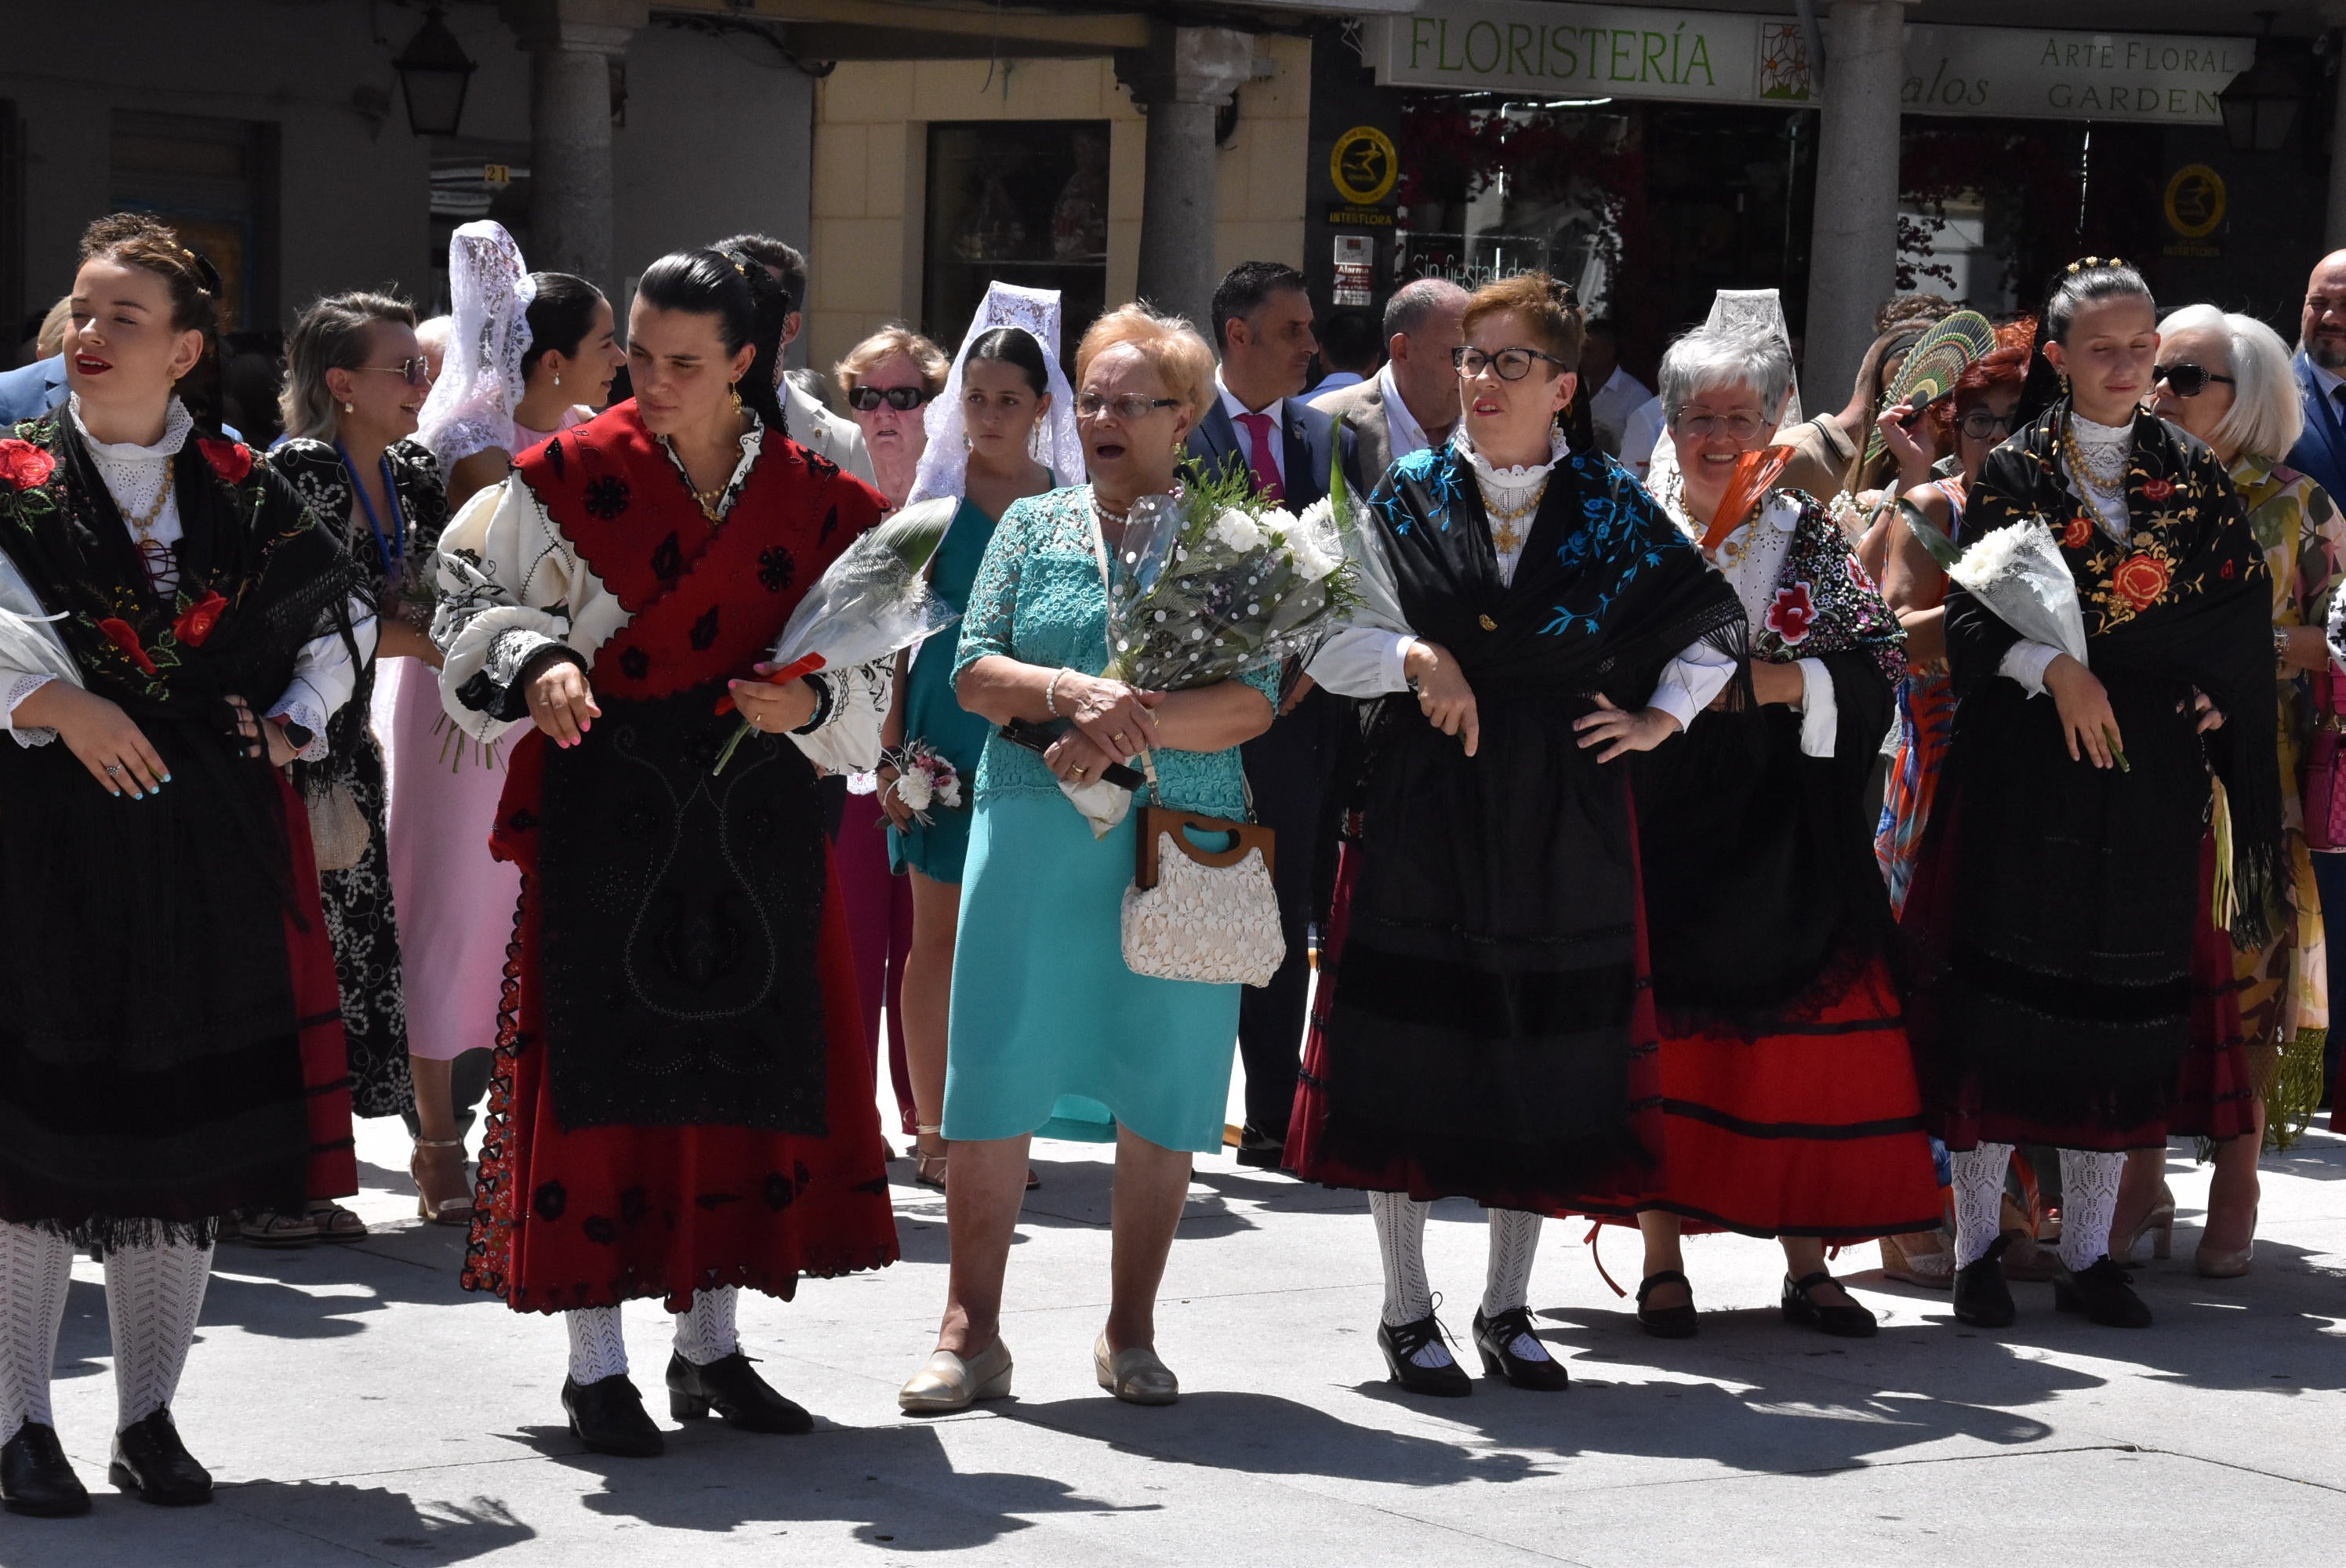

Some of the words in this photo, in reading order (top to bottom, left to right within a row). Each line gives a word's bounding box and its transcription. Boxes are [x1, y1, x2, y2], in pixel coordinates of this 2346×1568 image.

[1409, 17, 1716, 86] FLORISTERÍA
[2040, 38, 2115, 68] ARTE
[2126, 42, 2233, 73] FLORAL
[1900, 57, 1990, 106] alos
[2048, 84, 2221, 114] GARDEN
[488, 166, 507, 182] 21
[1329, 212, 1393, 226] INTERFLORA
[1337, 265, 1370, 274] Alarma
